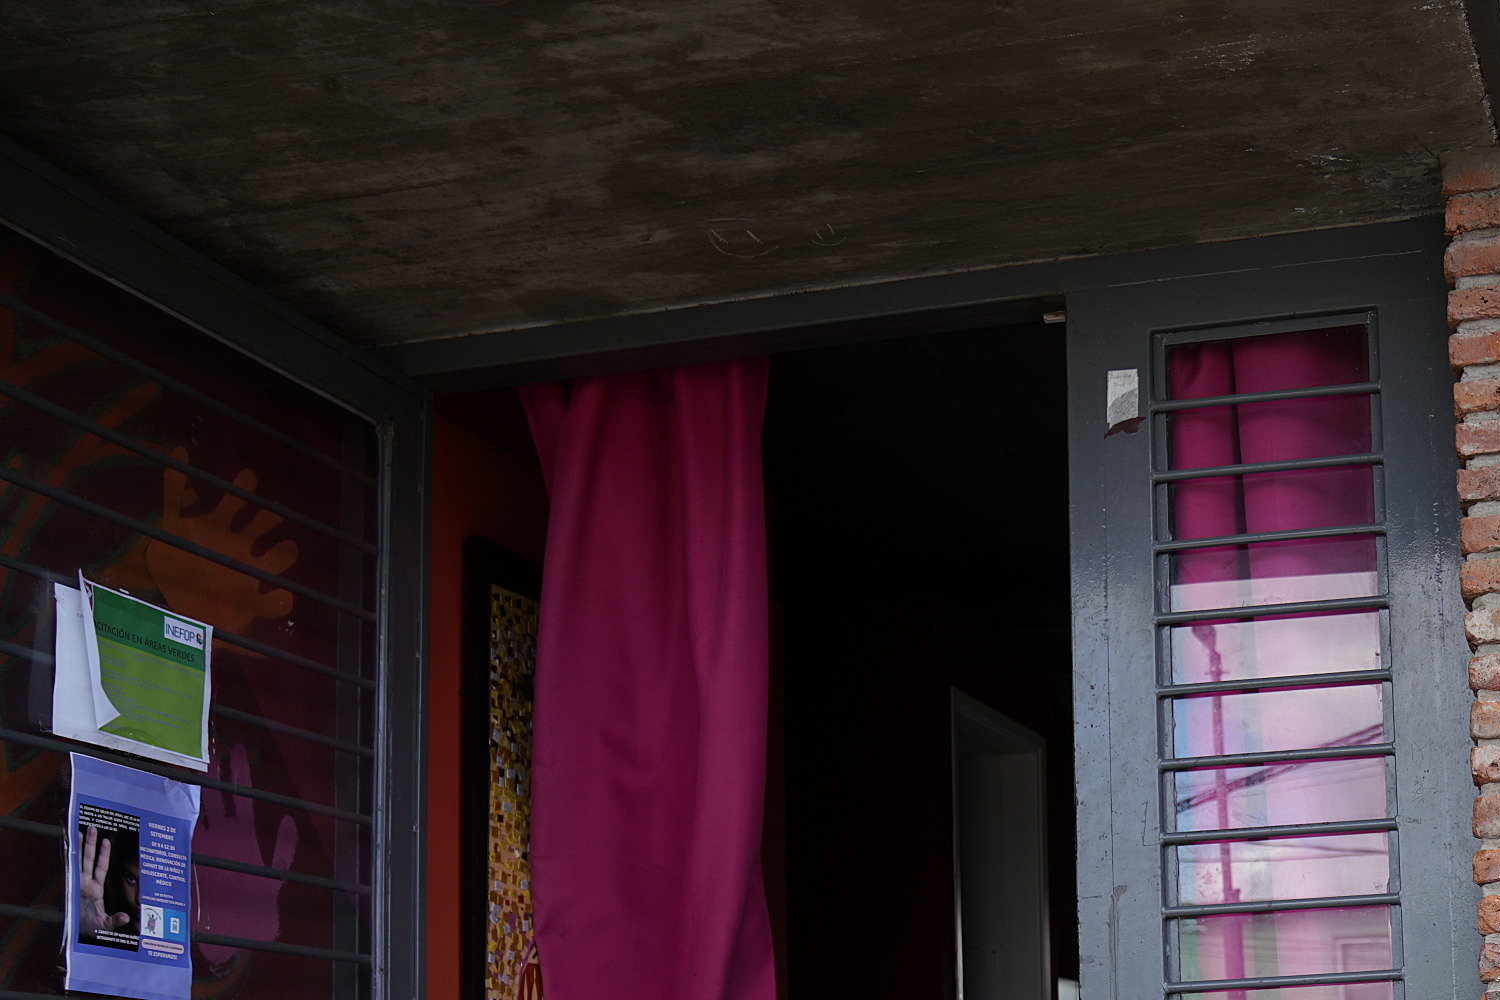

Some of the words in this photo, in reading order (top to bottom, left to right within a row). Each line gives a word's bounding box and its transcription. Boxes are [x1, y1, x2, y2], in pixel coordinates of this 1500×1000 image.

[165, 623, 195, 643] INEFOP
[132, 634, 143, 644] EN
[144, 638, 167, 653] ÁREAS
[167, 646, 195, 662] VERDES
